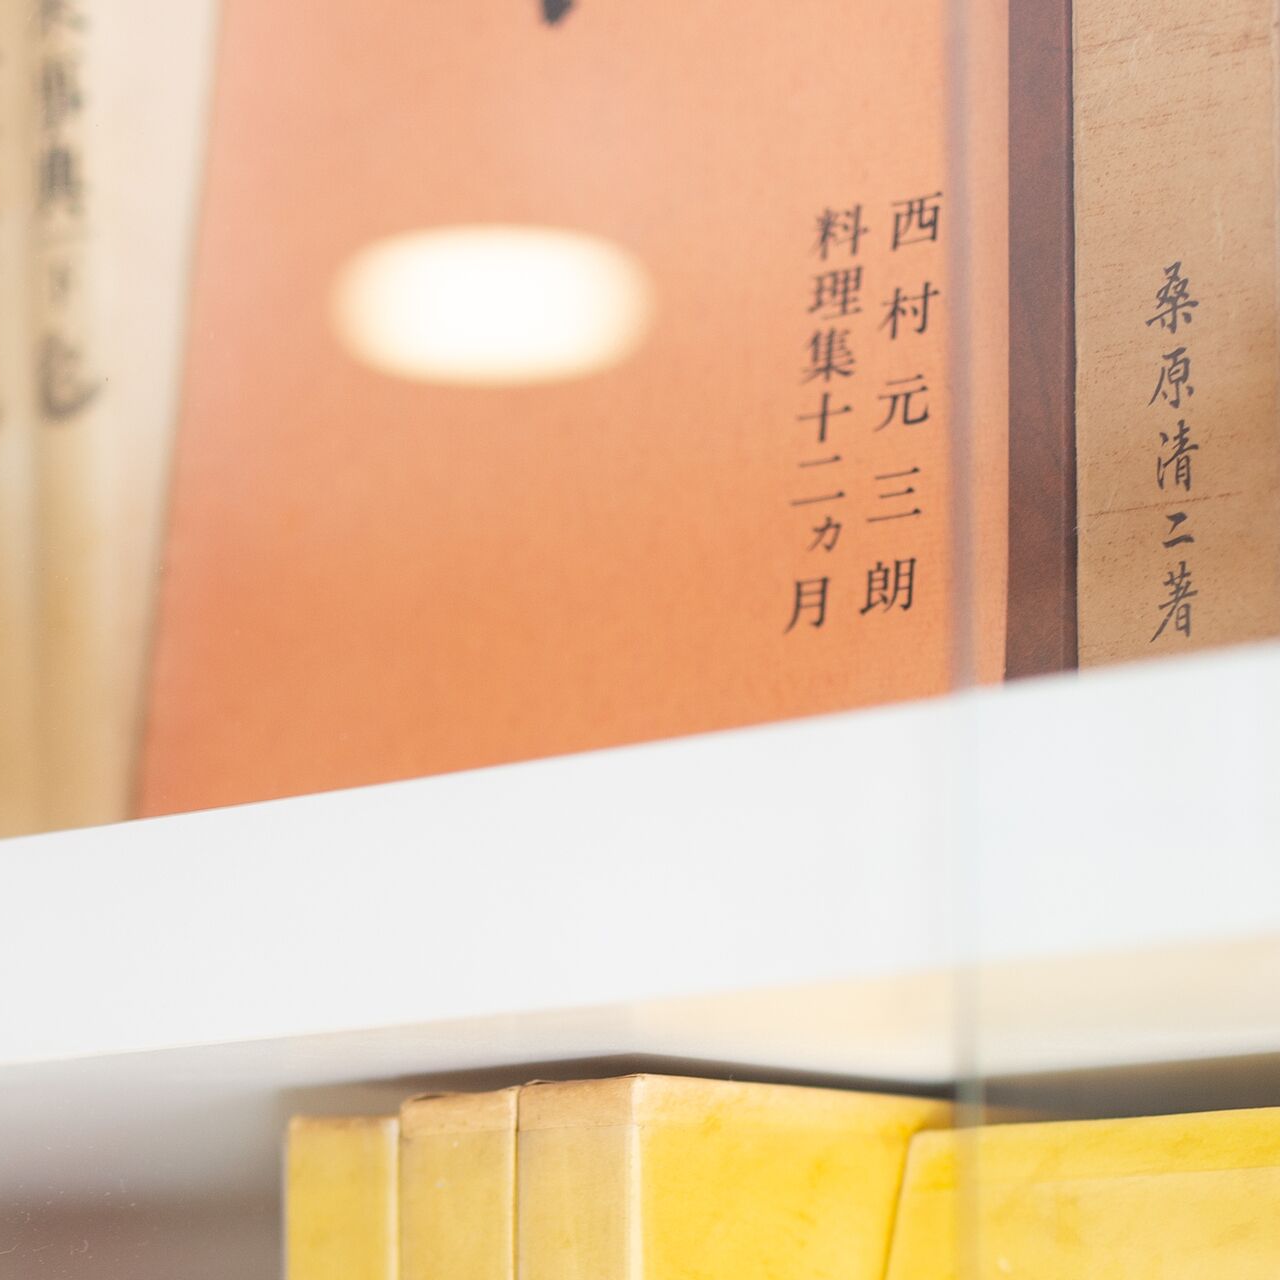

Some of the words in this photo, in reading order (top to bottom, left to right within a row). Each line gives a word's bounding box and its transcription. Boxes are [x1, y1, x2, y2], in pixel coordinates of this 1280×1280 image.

[859, 191, 944, 616] 西村元三朗
